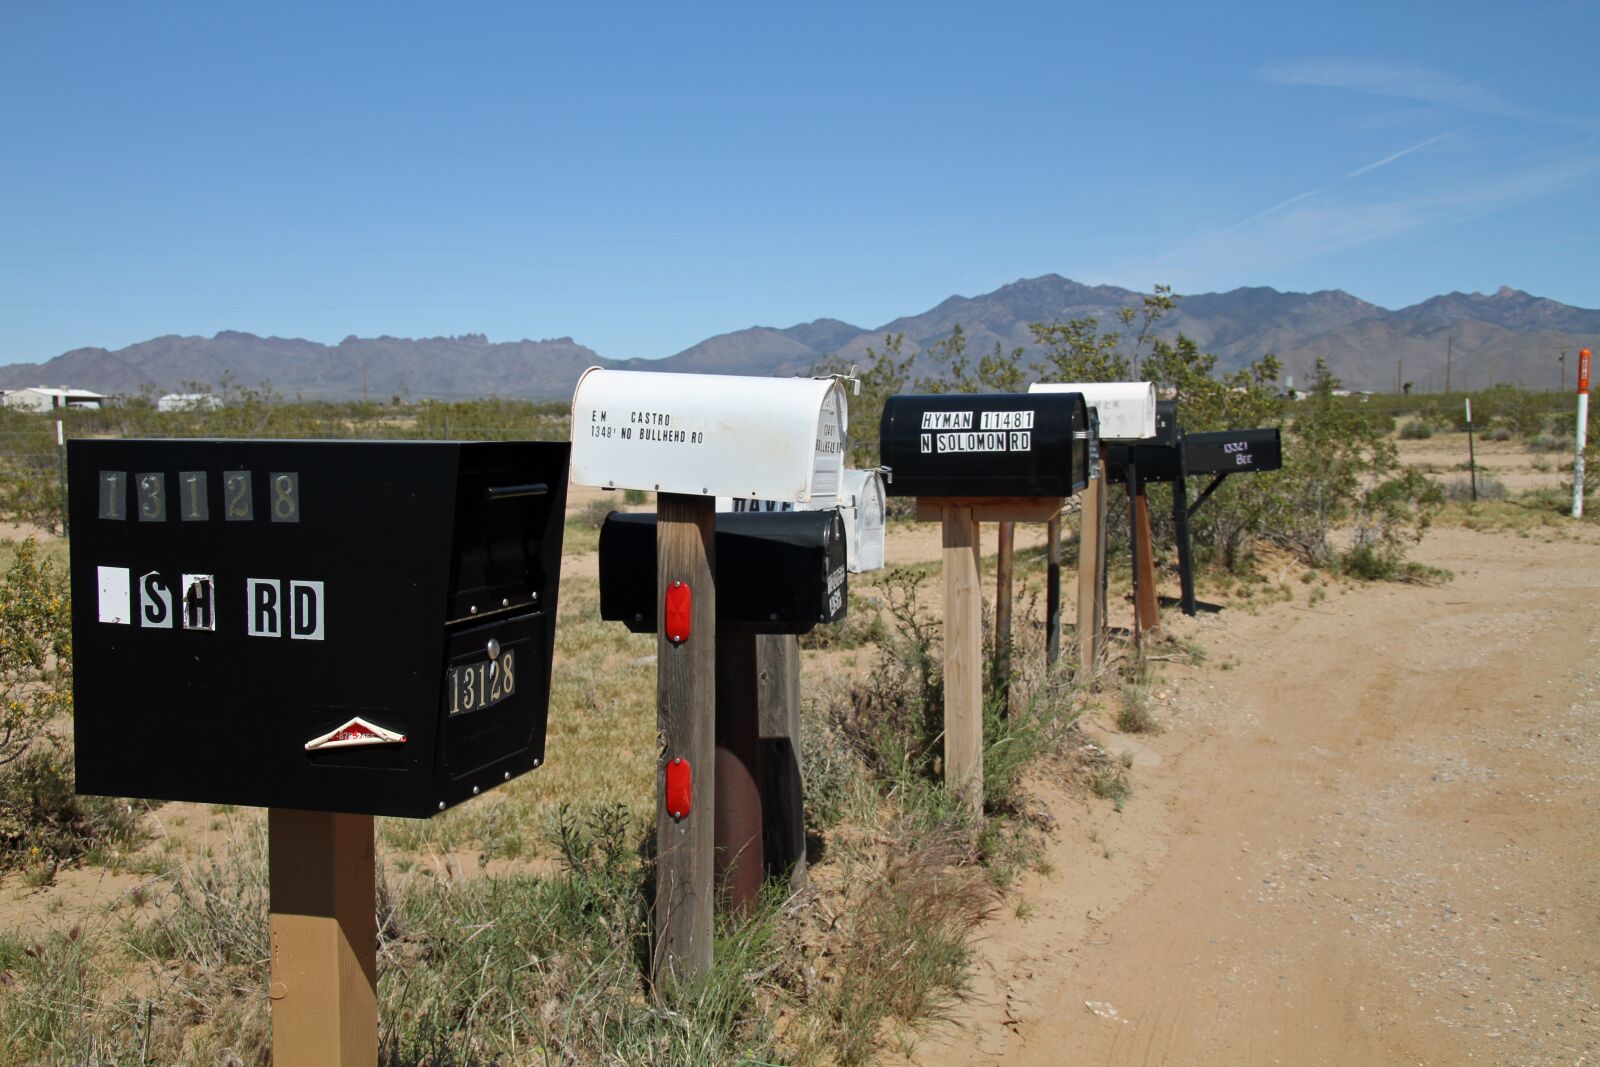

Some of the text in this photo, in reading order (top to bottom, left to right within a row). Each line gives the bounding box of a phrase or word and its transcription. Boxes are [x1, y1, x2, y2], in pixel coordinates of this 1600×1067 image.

[631, 411, 670, 426] CASTRO
[923, 412, 1032, 428] HYMAN 11481
[621, 427, 632, 440] NO
[922, 432, 1029, 452] N SOLOMON RD
[106, 473, 295, 519] 13128
[255, 582, 317, 636] RD
[451, 653, 514, 713] 13128
